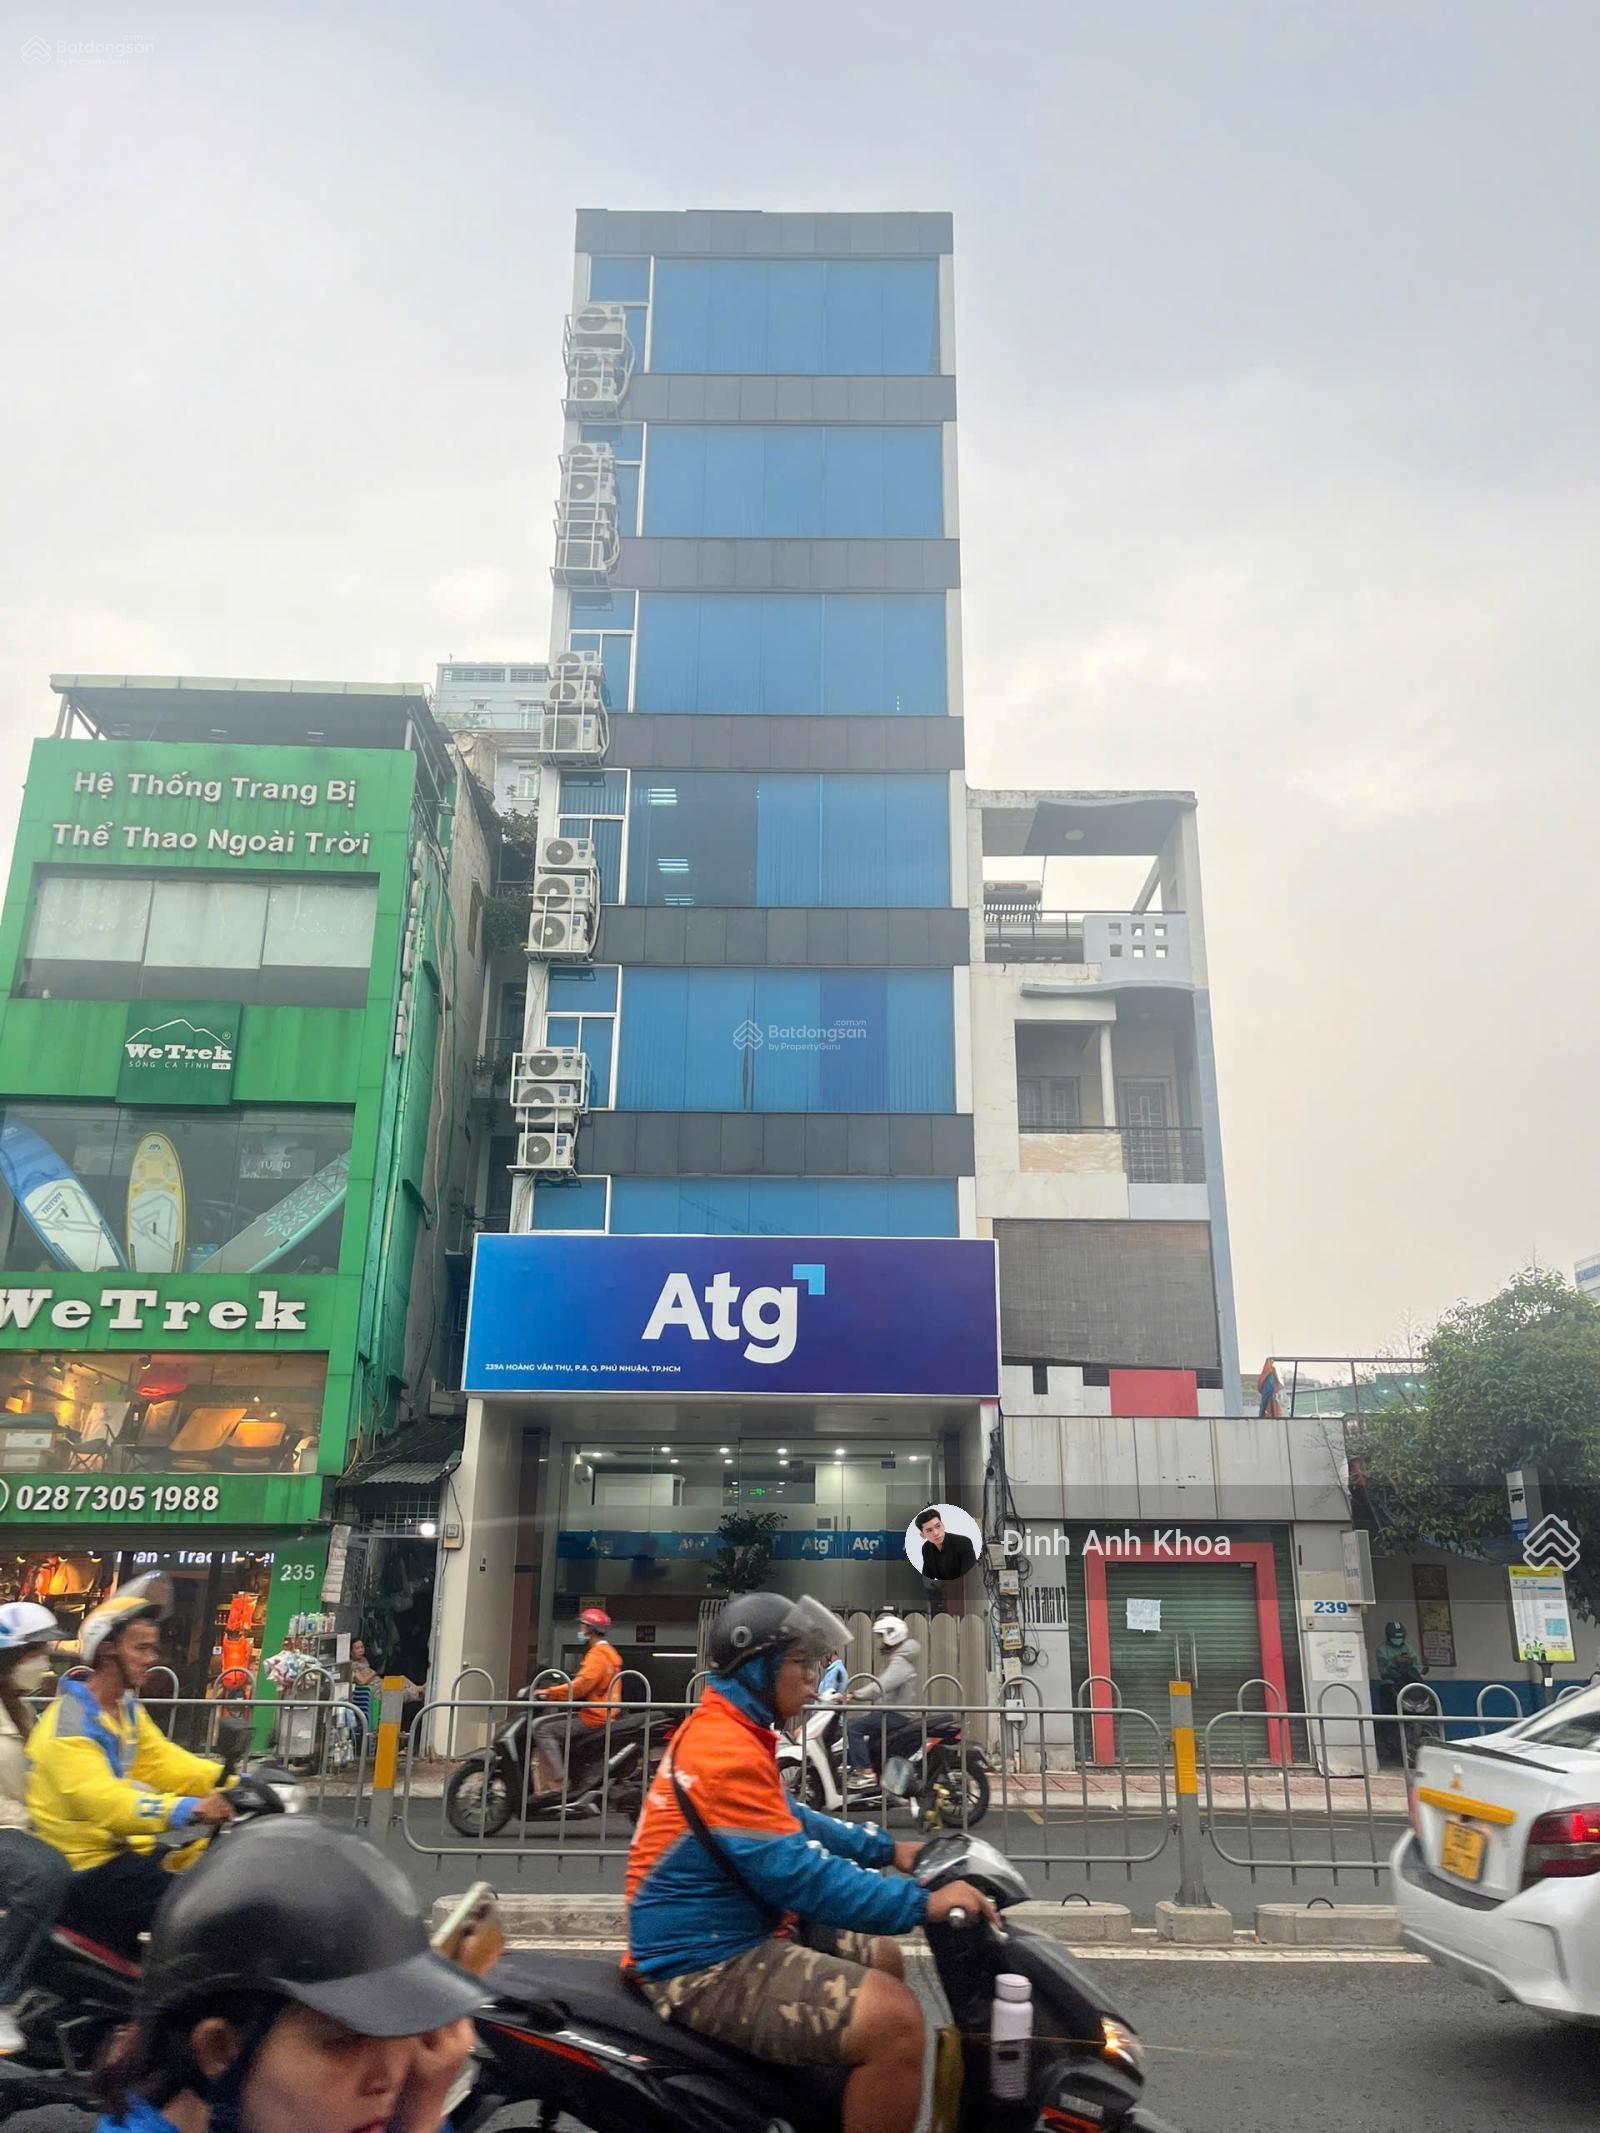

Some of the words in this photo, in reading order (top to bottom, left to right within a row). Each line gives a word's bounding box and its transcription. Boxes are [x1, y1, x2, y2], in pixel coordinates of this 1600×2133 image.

[74, 771, 114, 799] Hệ
[127, 771, 222, 803] Thống
[231, 777, 317, 806] Trang
[326, 780, 356, 808] Bị
[53, 822, 114, 848] Thể
[123, 826, 198, 849] Thao
[207, 829, 295, 856] Ngoài
[305, 830, 370, 855] Trời
[125, 1043, 232, 1060] WeTrek
[0, 1289, 306, 1330] WeTrek
[641, 1271, 798, 1364] Atg
[280, 1564, 315, 1582] 235
[1314, 1601, 1349, 1614] 239
